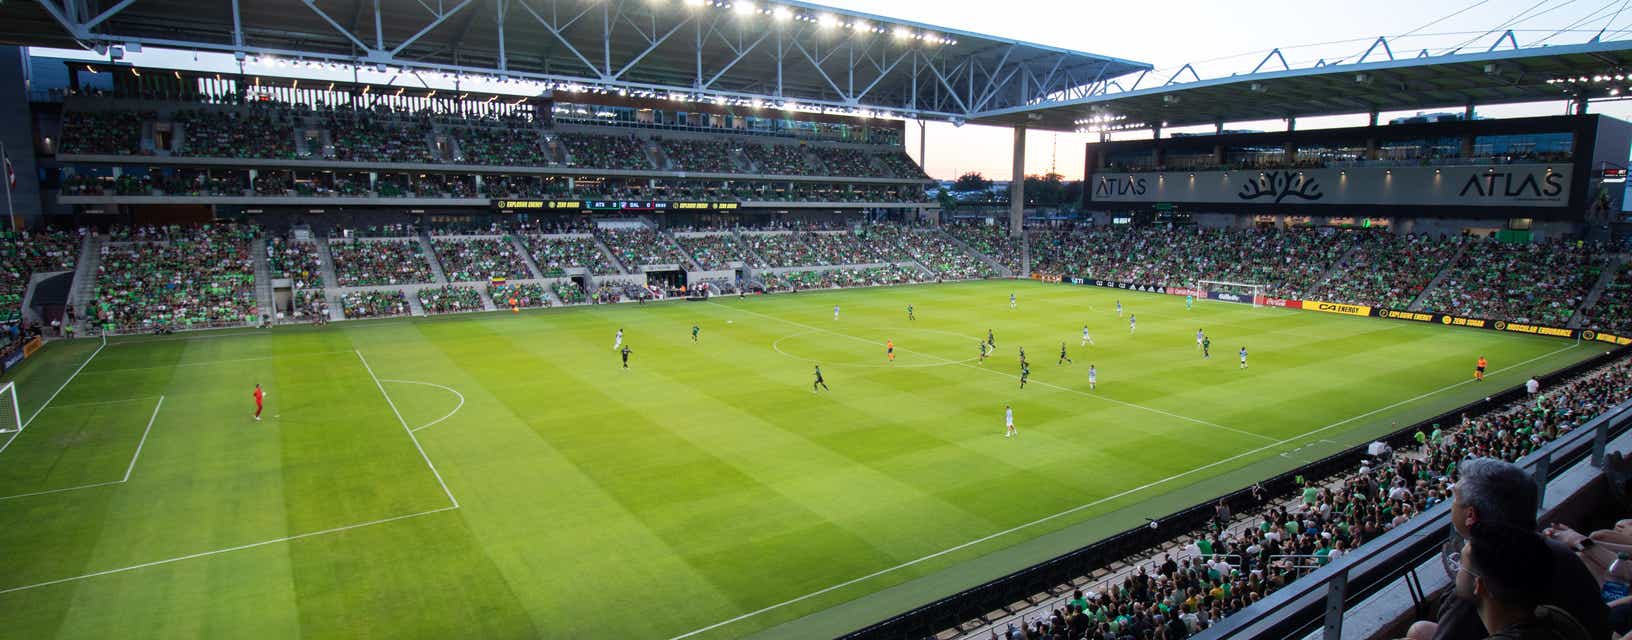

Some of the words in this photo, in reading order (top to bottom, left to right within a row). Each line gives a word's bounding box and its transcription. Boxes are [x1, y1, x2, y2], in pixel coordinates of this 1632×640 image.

[1096, 178, 1146, 195] ATLAS
[1459, 173, 1563, 197] ATLAS
[1319, 303, 1336, 311] C4
[1337, 305, 1360, 313] ENERGY
[1389, 310, 1413, 320] EXPLOSIVE
[1413, 313, 1433, 321] ENERGY
[1453, 317, 1466, 325] ZERO
[1466, 319, 1485, 327] SUGAR
[1506, 322, 1538, 333] MUSCULAR
[1538, 326, 1573, 337] ENDURANCE
